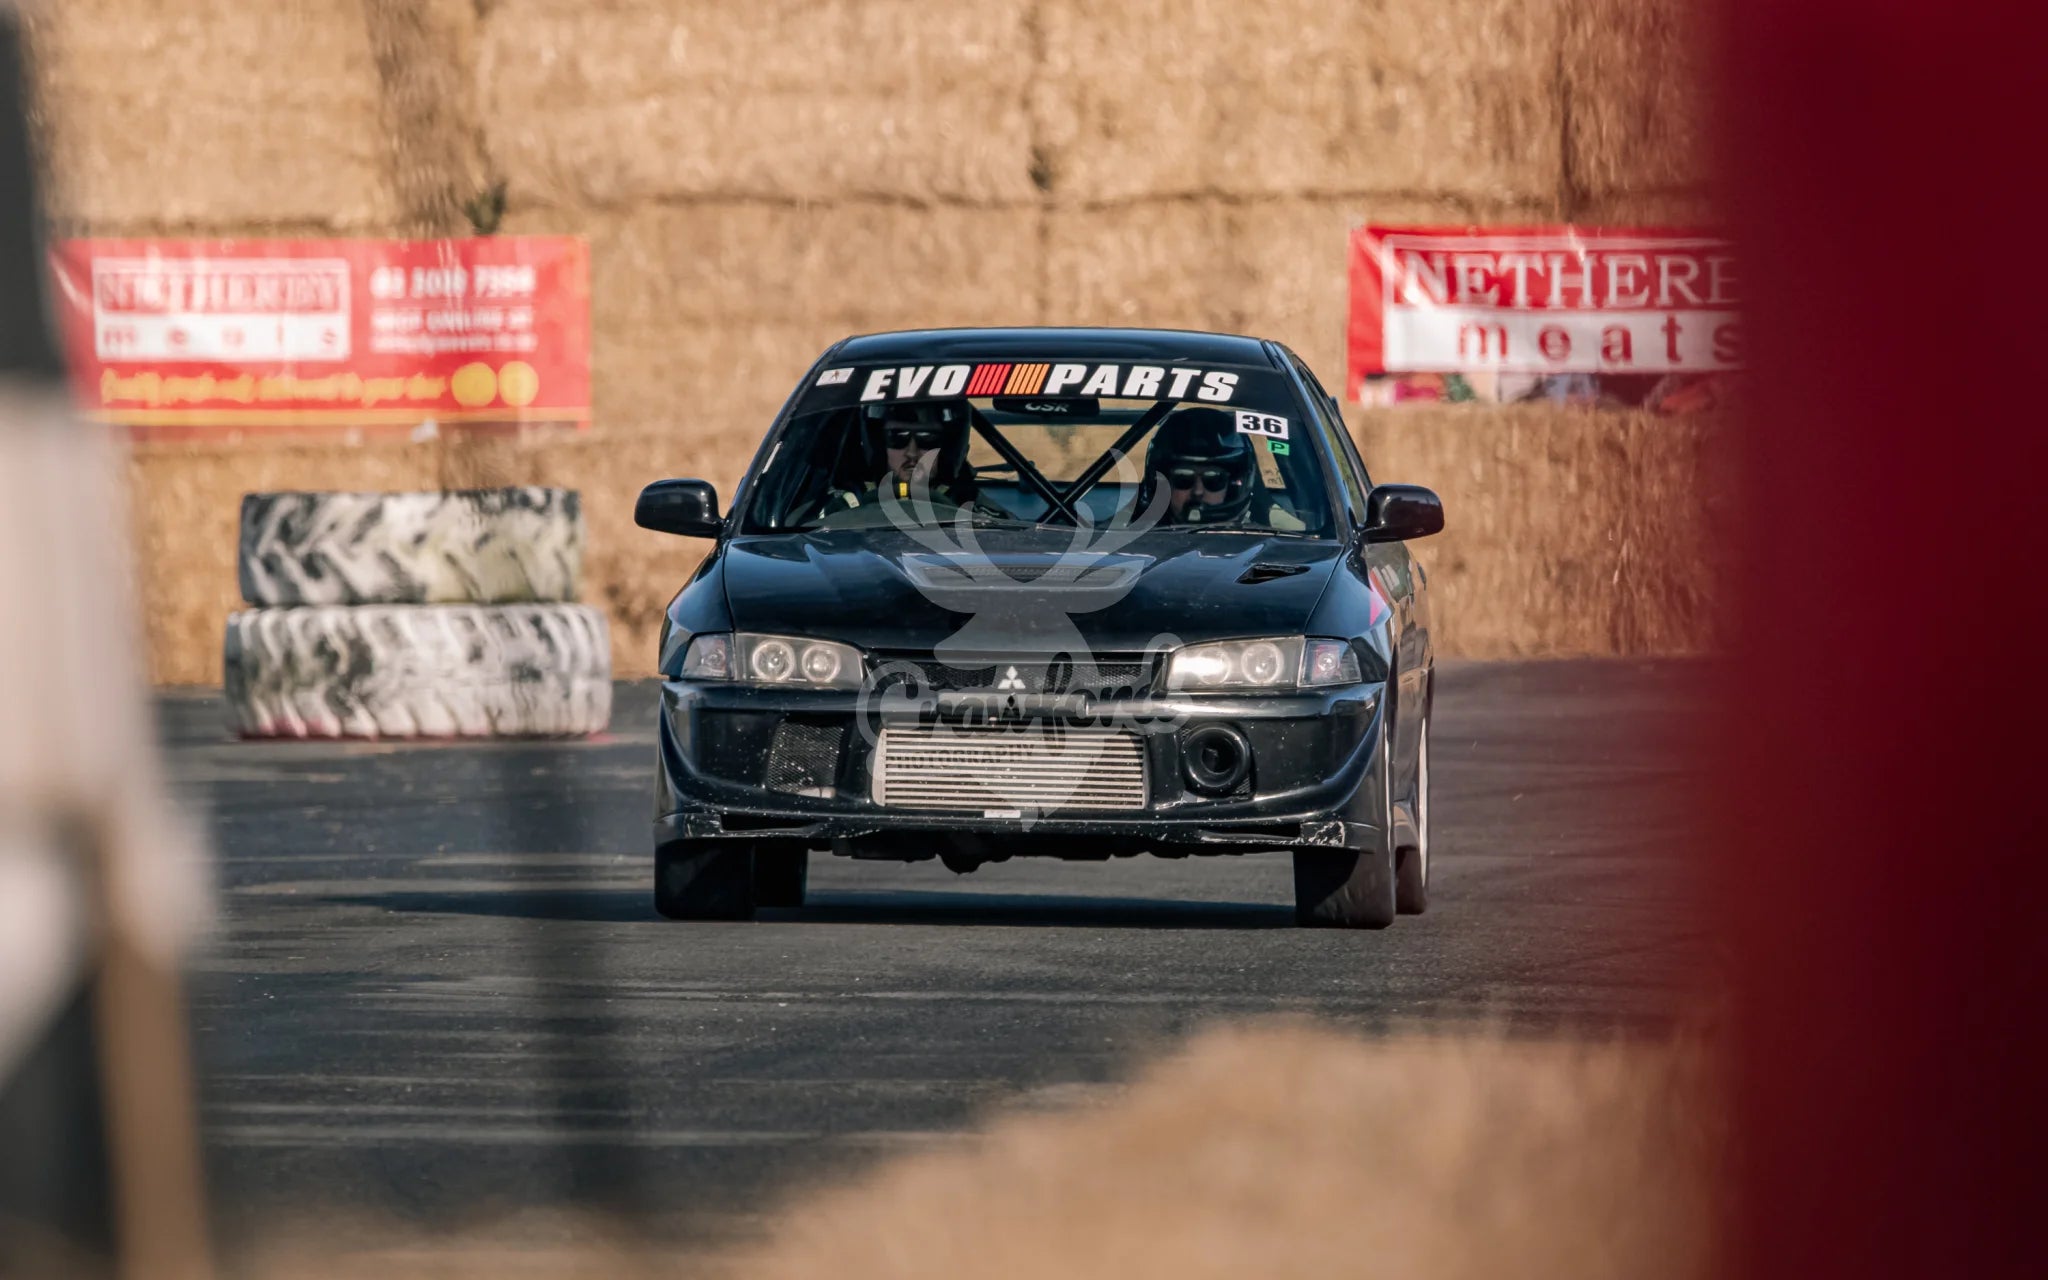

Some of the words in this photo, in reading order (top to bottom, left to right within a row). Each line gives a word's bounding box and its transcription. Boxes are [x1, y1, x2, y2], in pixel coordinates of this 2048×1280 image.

[860, 364, 971, 401] EVO
[1043, 364, 1240, 401] PARTS
[1241, 414, 1283, 434] 36
[1271, 442, 1286, 452] P
